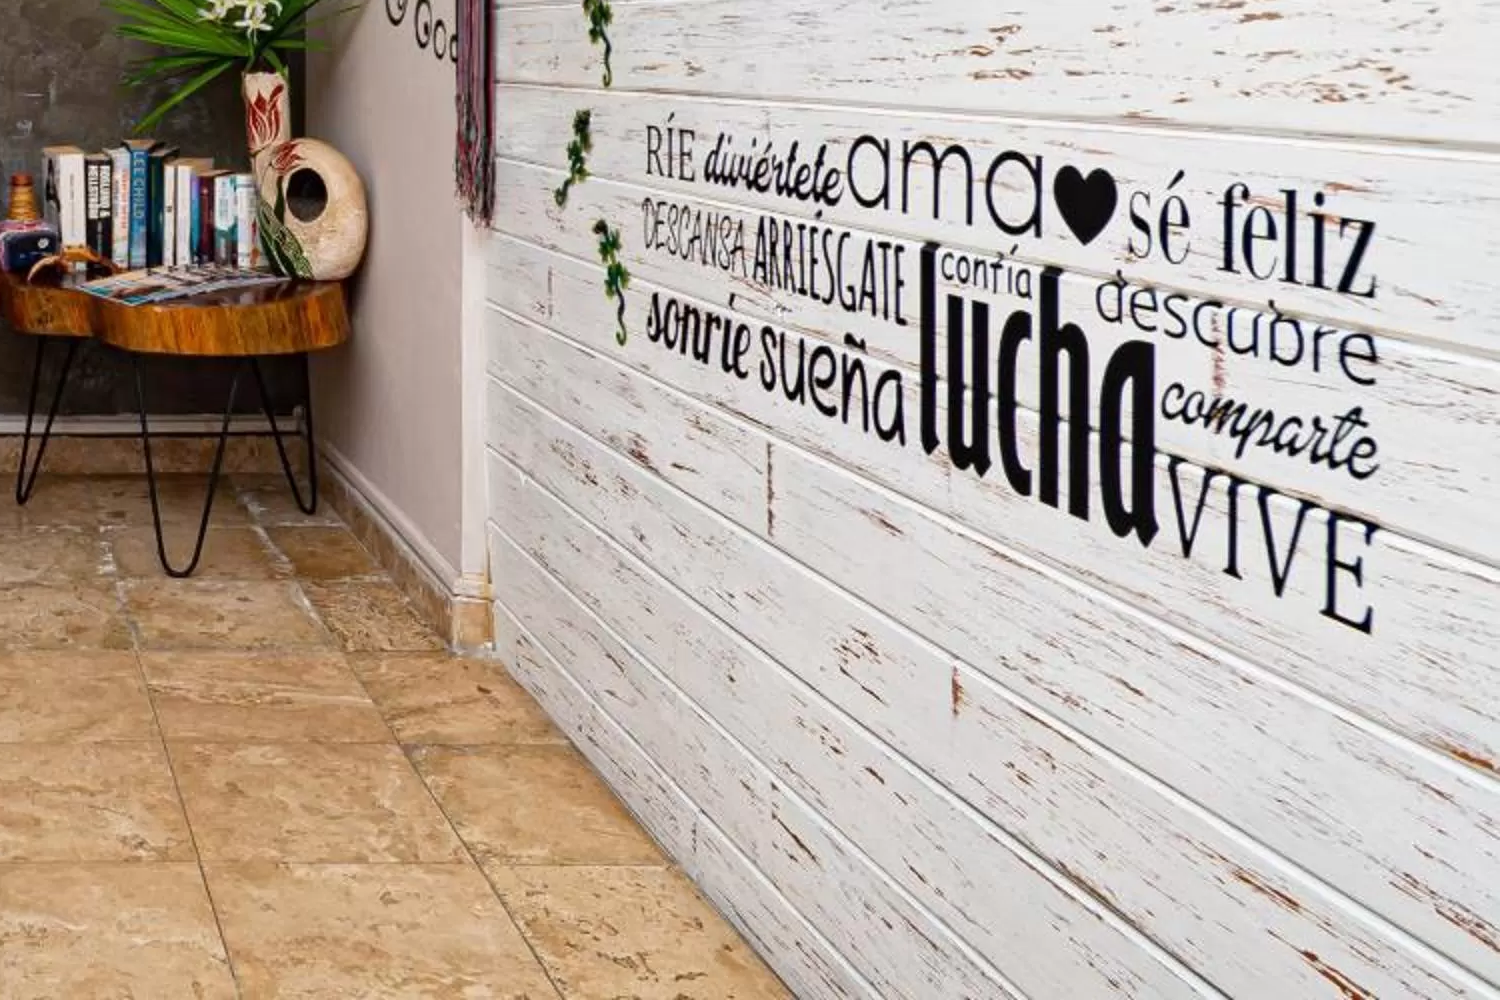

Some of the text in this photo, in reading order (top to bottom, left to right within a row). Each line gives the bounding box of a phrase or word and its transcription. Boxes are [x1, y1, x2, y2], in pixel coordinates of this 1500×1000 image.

[132, 177, 146, 219] CHILD
[645, 111, 1042, 239] RÍE diviértete ama
[1128, 169, 1378, 299] sé feliz
[641, 197, 909, 326] DESCANSA ARRIÉSGATE
[941, 243, 1033, 300] confía
[758, 324, 907, 448] sueña
[1095, 268, 1379, 386] descubre
[919, 240, 1160, 549] lucha
[1160, 382, 1380, 480] comparte
[1167, 453, 1386, 636] VIVE
